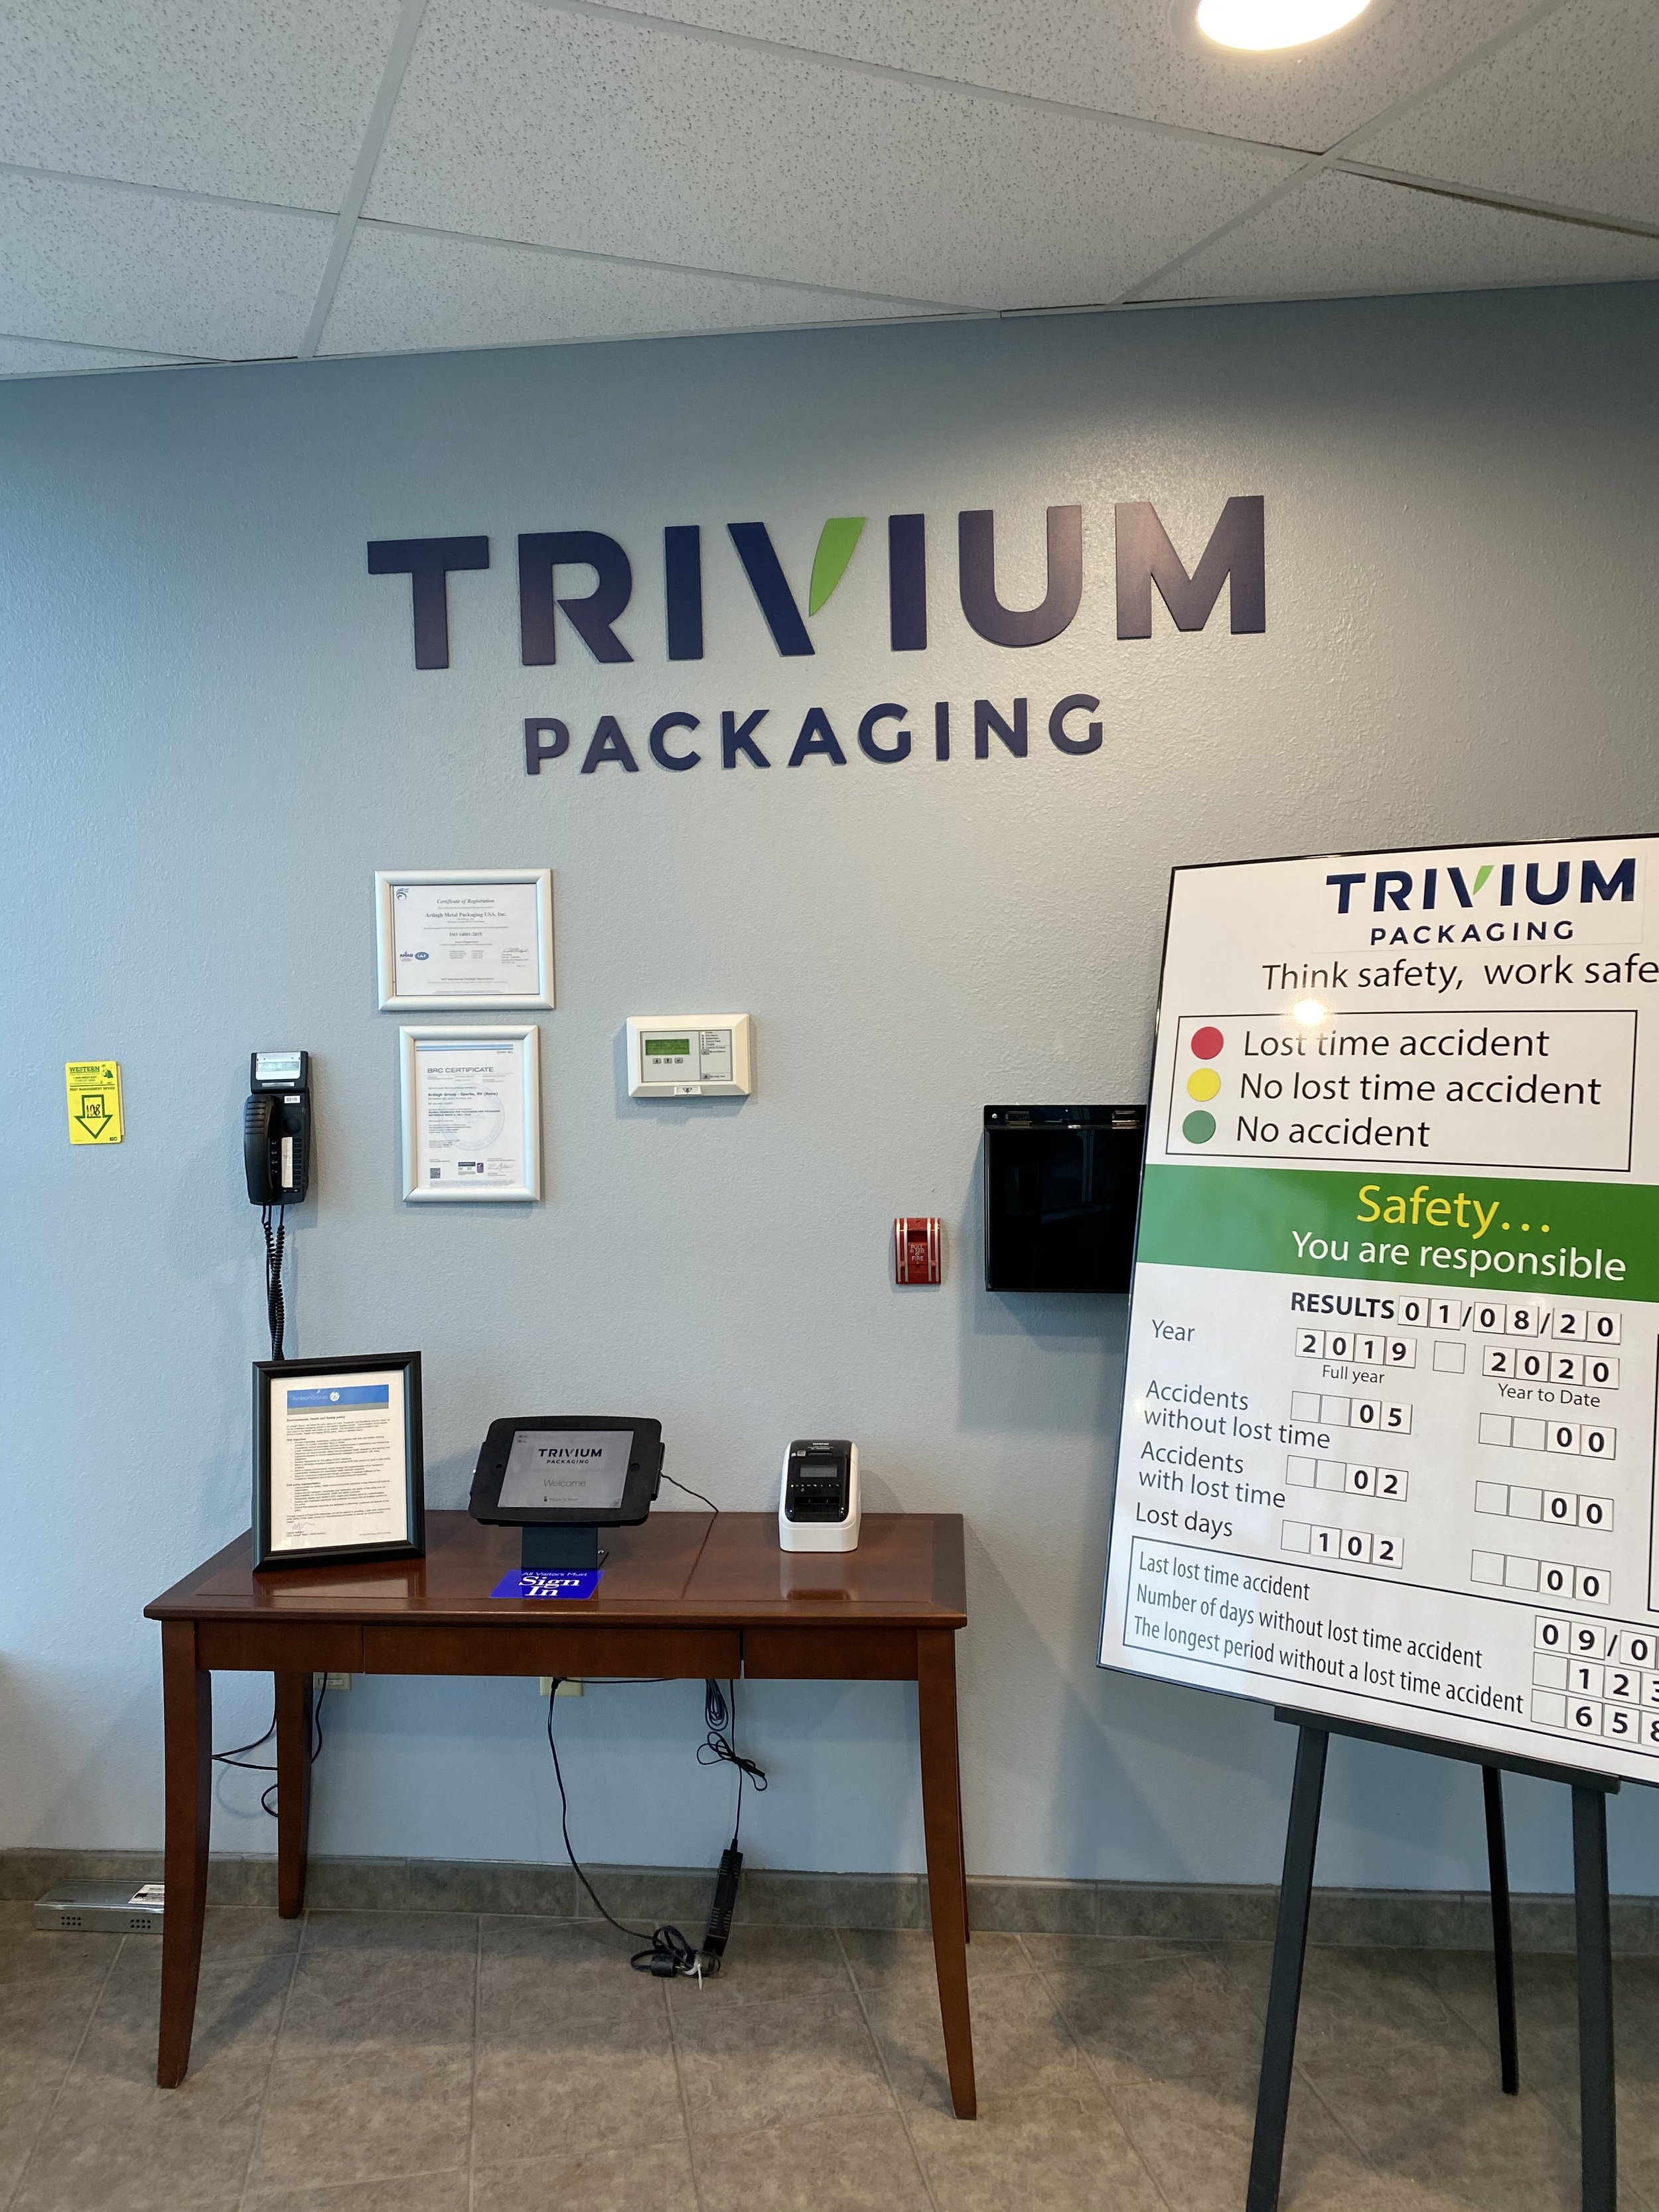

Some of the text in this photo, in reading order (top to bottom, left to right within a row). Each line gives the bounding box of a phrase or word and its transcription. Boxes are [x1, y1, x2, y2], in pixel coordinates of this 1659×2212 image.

[368, 495, 1265, 670] TRIVIUM
[524, 694, 1104, 775] PACKAGING
[1326, 858, 1637, 914] TRIVIUM
[1370, 921, 1575, 946] PACKAGING
[1262, 952, 1659, 992] Think safety, work safe
[1244, 1027, 1550, 1057] Lost time accident
[1240, 1072, 1601, 1105] No lost time accident
[1237, 1116, 1430, 1147] No accident
[1292, 1230, 1626, 1282] You are responsible
[1291, 1292, 1394, 1319] RESULTS
[1152, 1319, 1195, 1342] Year
[1322, 1364, 1386, 1384] Full year
[1145, 1380, 1249, 1410] Accidents
[1498, 1383, 1601, 1408] Year to Date
[1144, 1408, 1331, 1449] without lost time
[538, 1448, 603, 1457] TRIVIUM
[1141, 1441, 1244, 1473] Accidents
[543, 1479, 586, 1487] Welcome
[1139, 1469, 1286, 1509] with lost time
[1136, 1502, 1233, 1540] Lost days
[518, 1576, 580, 1589] Sign
[525, 1586, 558, 1596] In
[1139, 1551, 1310, 1601] Last lost time accident
[1137, 1583, 1482, 1668] Number of days without lost time accident
[1135, 1615, 1524, 1714] The longest period without a lost time accident
